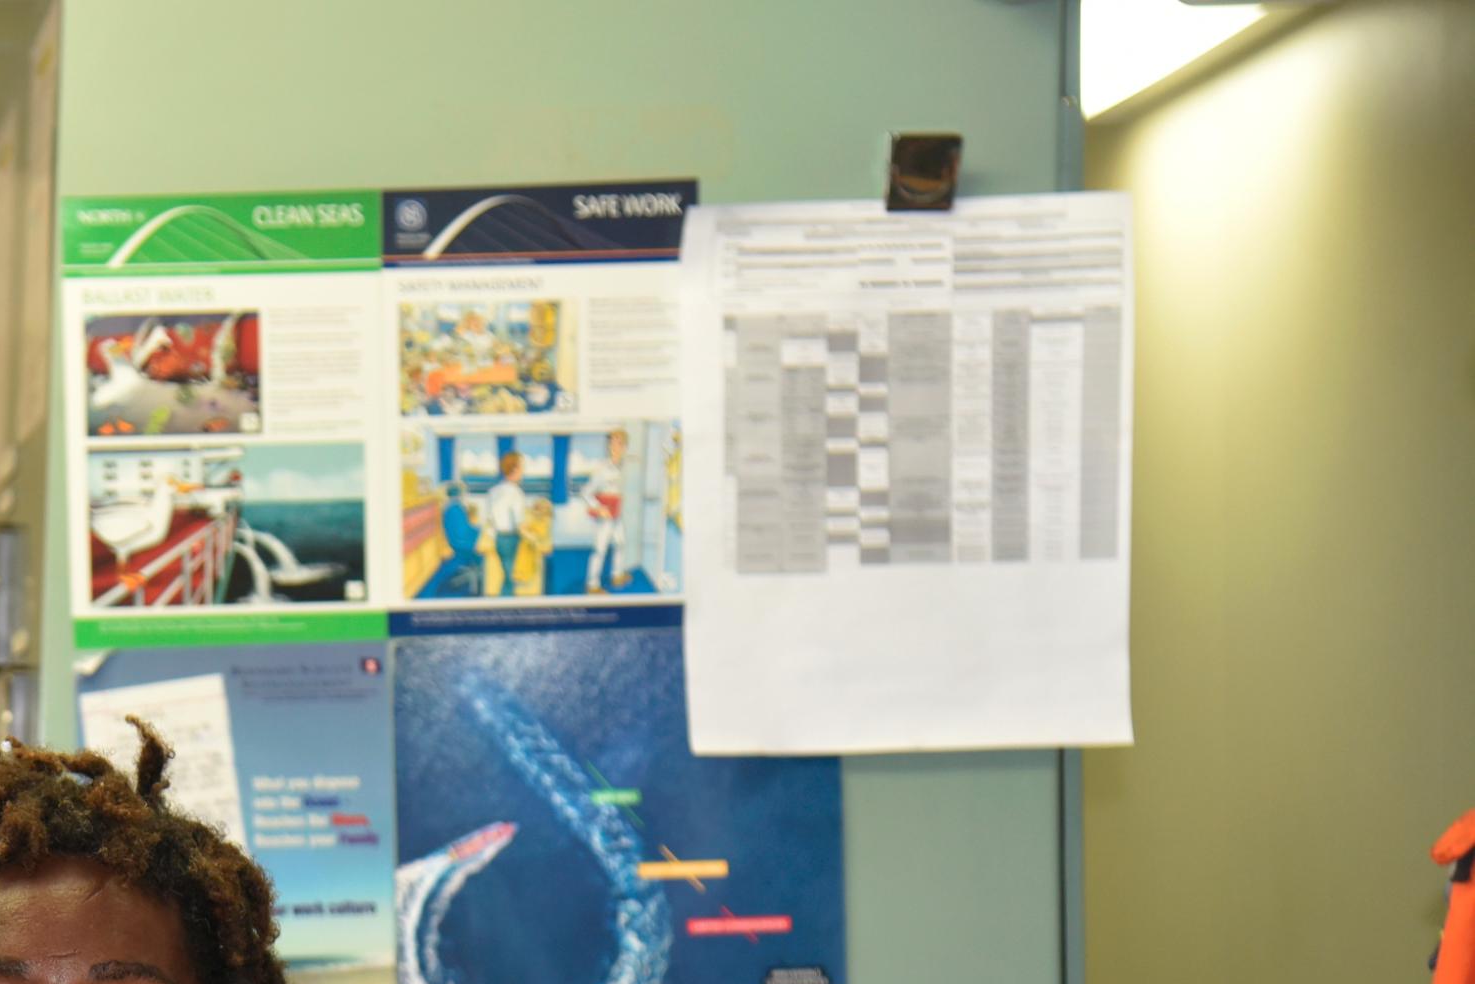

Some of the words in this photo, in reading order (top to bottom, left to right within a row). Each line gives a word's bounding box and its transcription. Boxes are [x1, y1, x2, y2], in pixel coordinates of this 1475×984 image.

[251, 203, 315, 230] CLEAN
[318, 202, 365, 229] SEAS
[572, 193, 621, 219] SAFE
[623, 191, 683, 217] WORK
[157, 285, 216, 304] WATER
